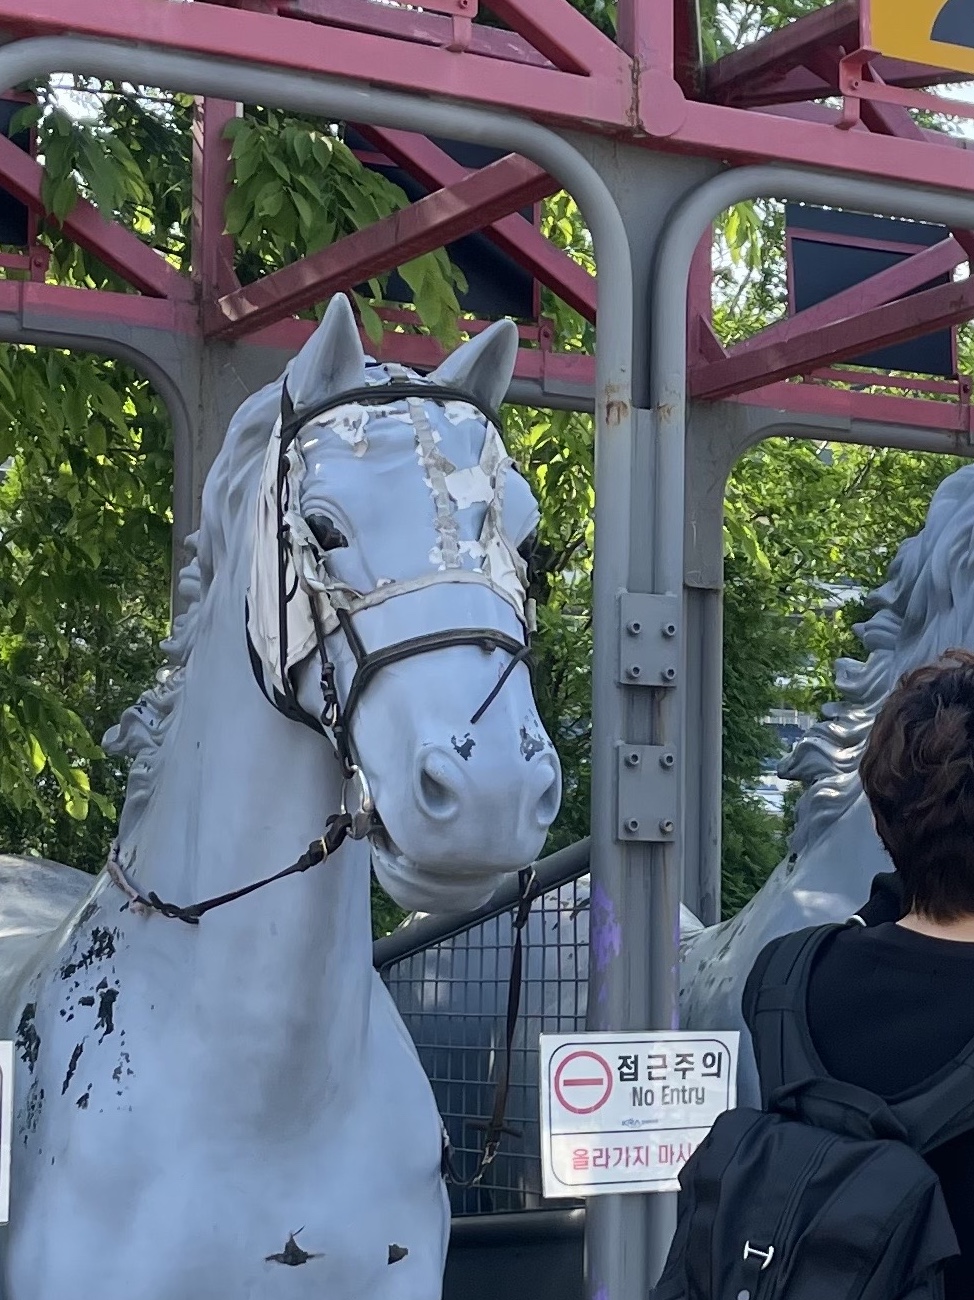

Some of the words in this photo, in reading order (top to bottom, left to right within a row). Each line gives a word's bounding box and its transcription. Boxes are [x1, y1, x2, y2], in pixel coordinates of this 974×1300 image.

[632, 1086, 655, 1107] No
[661, 1084, 706, 1106] Entry
[571, 1145, 650, 1171] 올라가지
[657, 1142, 700, 1168] 마시
